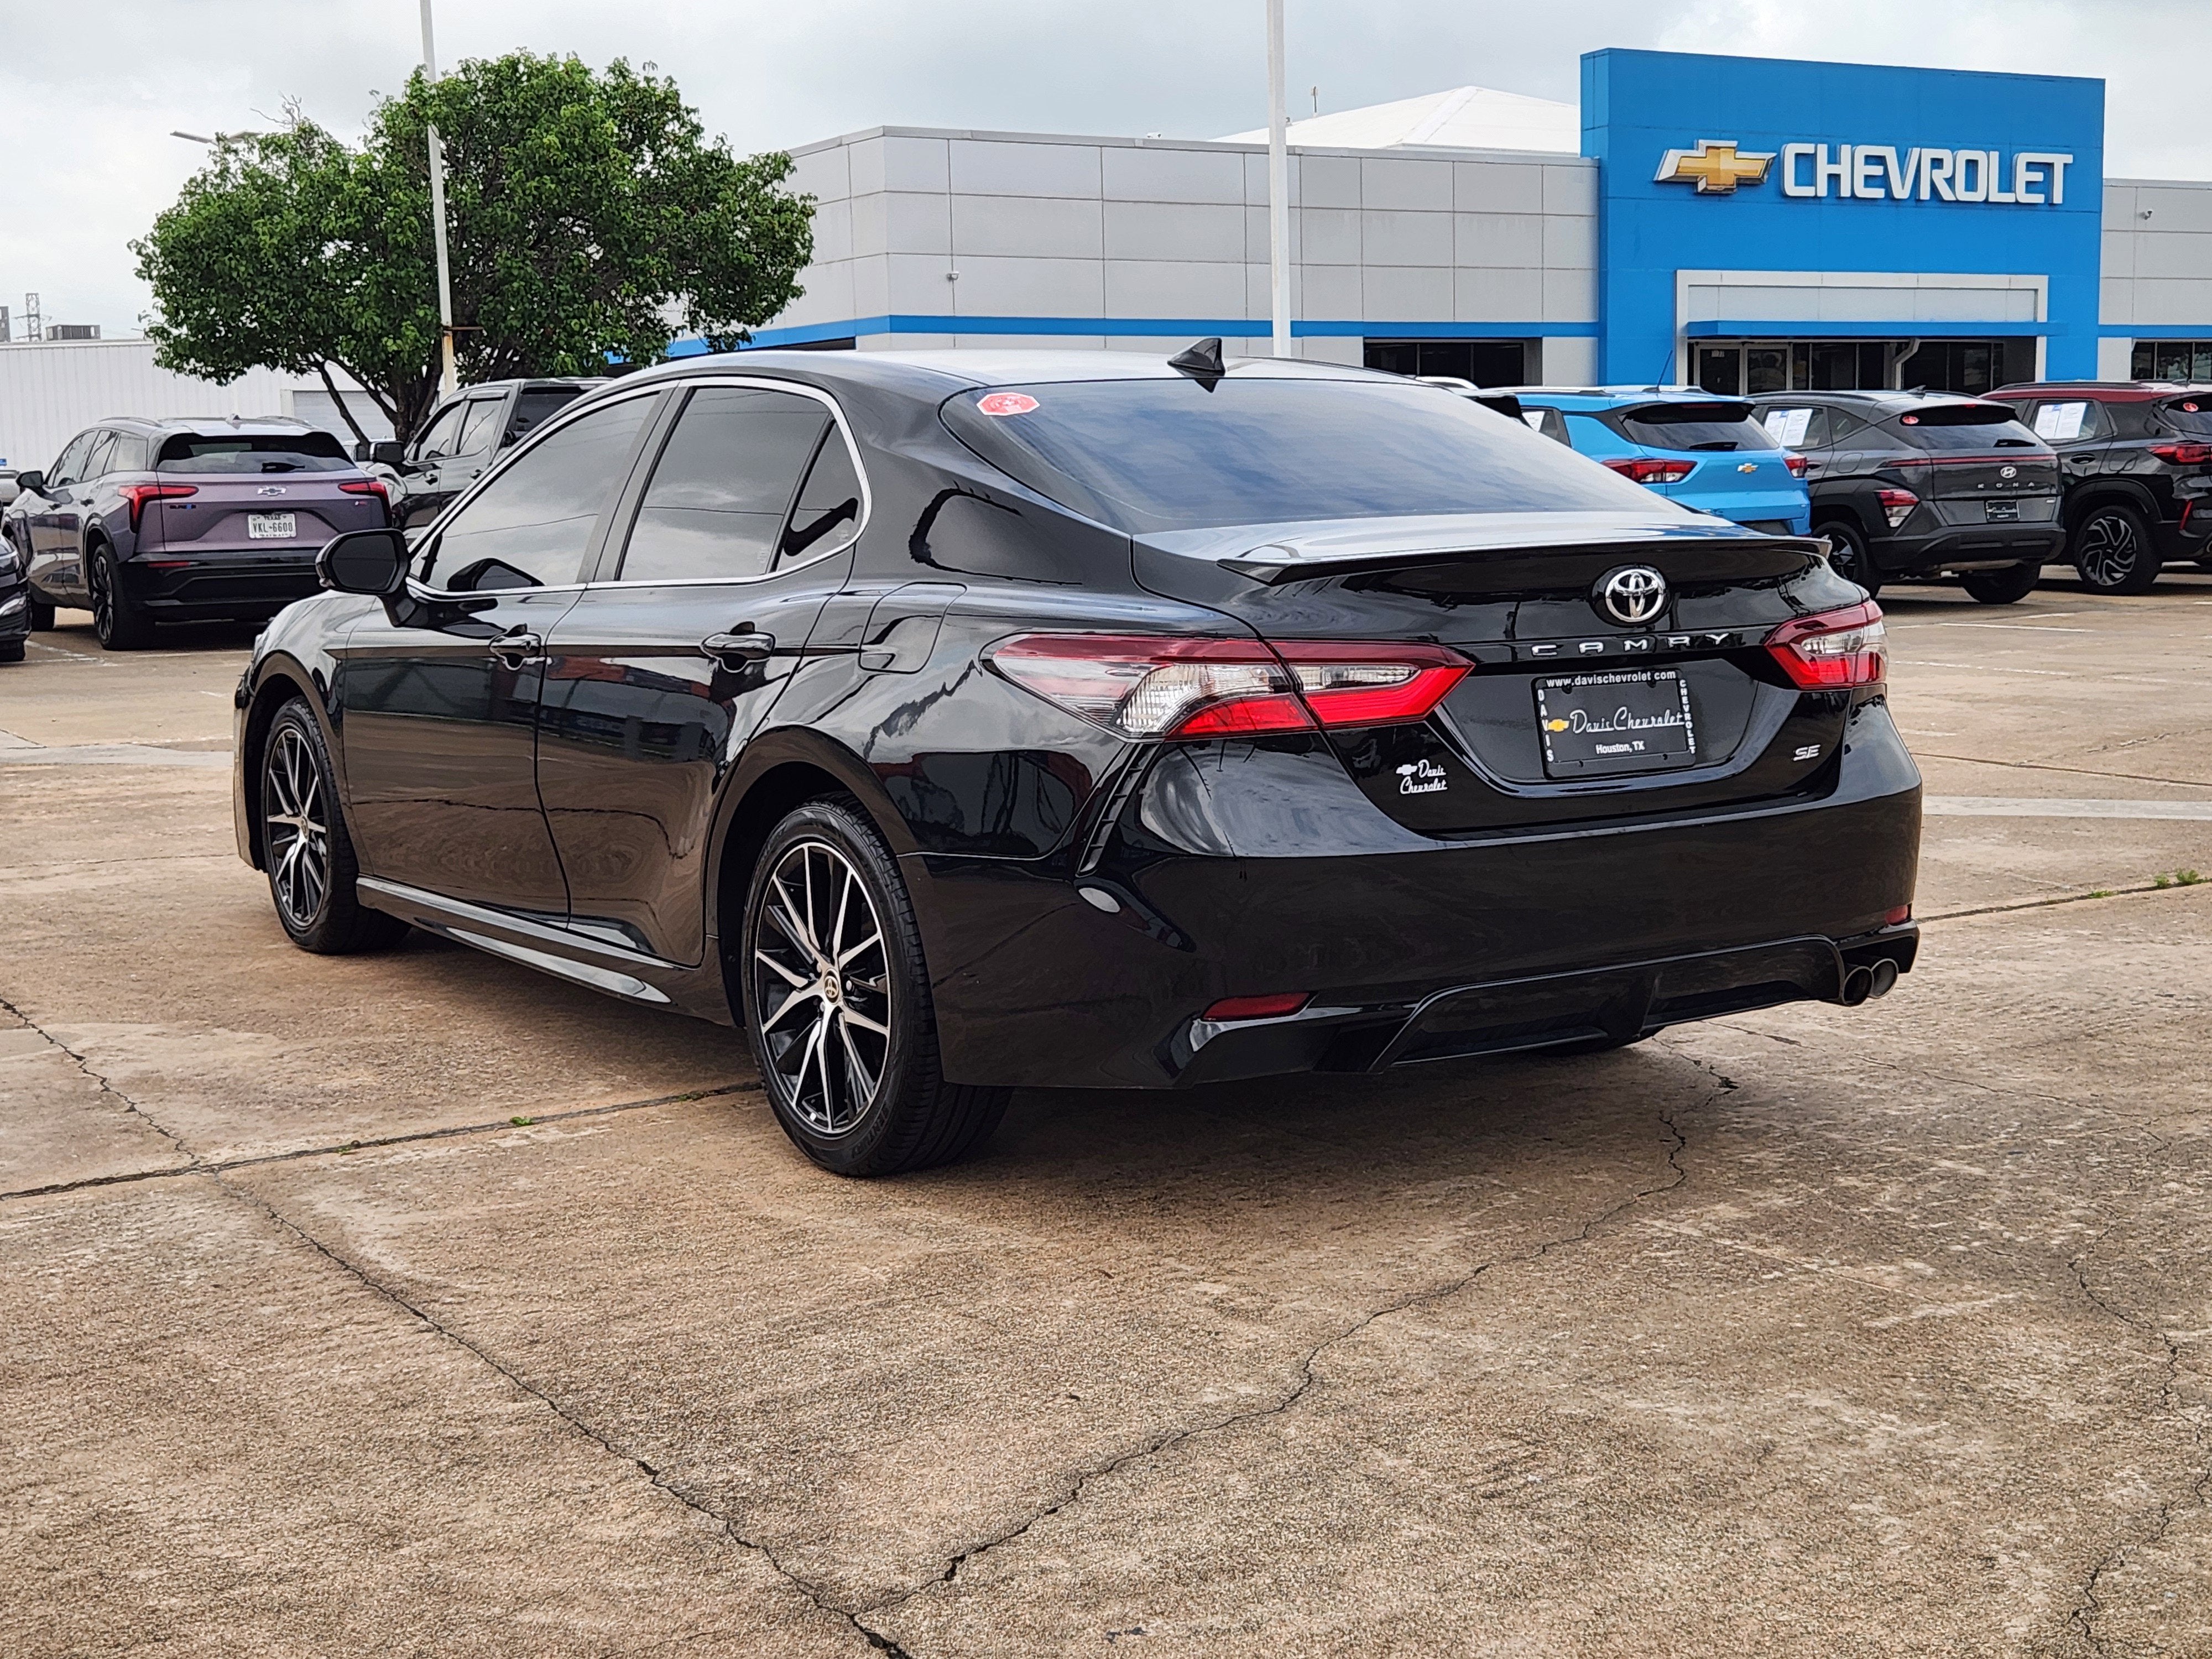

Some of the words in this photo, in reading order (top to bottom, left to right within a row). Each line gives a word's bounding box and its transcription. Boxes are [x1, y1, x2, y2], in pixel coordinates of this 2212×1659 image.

[1781, 143, 2073, 204] CHEVROLET
[1531, 633, 1729, 656] CAMRY
[1546, 671, 1676, 687] www.davischevroletcom
[1537, 689, 1554, 762] DAVIS
[1569, 709, 1614, 734] Davis
[1613, 706, 1685, 731] Chevrolet
[1679, 680, 1696, 754] CHEVROLET
[1595, 743, 1632, 754] Houston,
[1633, 740, 1645, 751] TX
[1793, 744, 1821, 761] SE
[1418, 759, 1447, 778] Davis
[1400, 776, 1448, 794] Chevrolet
